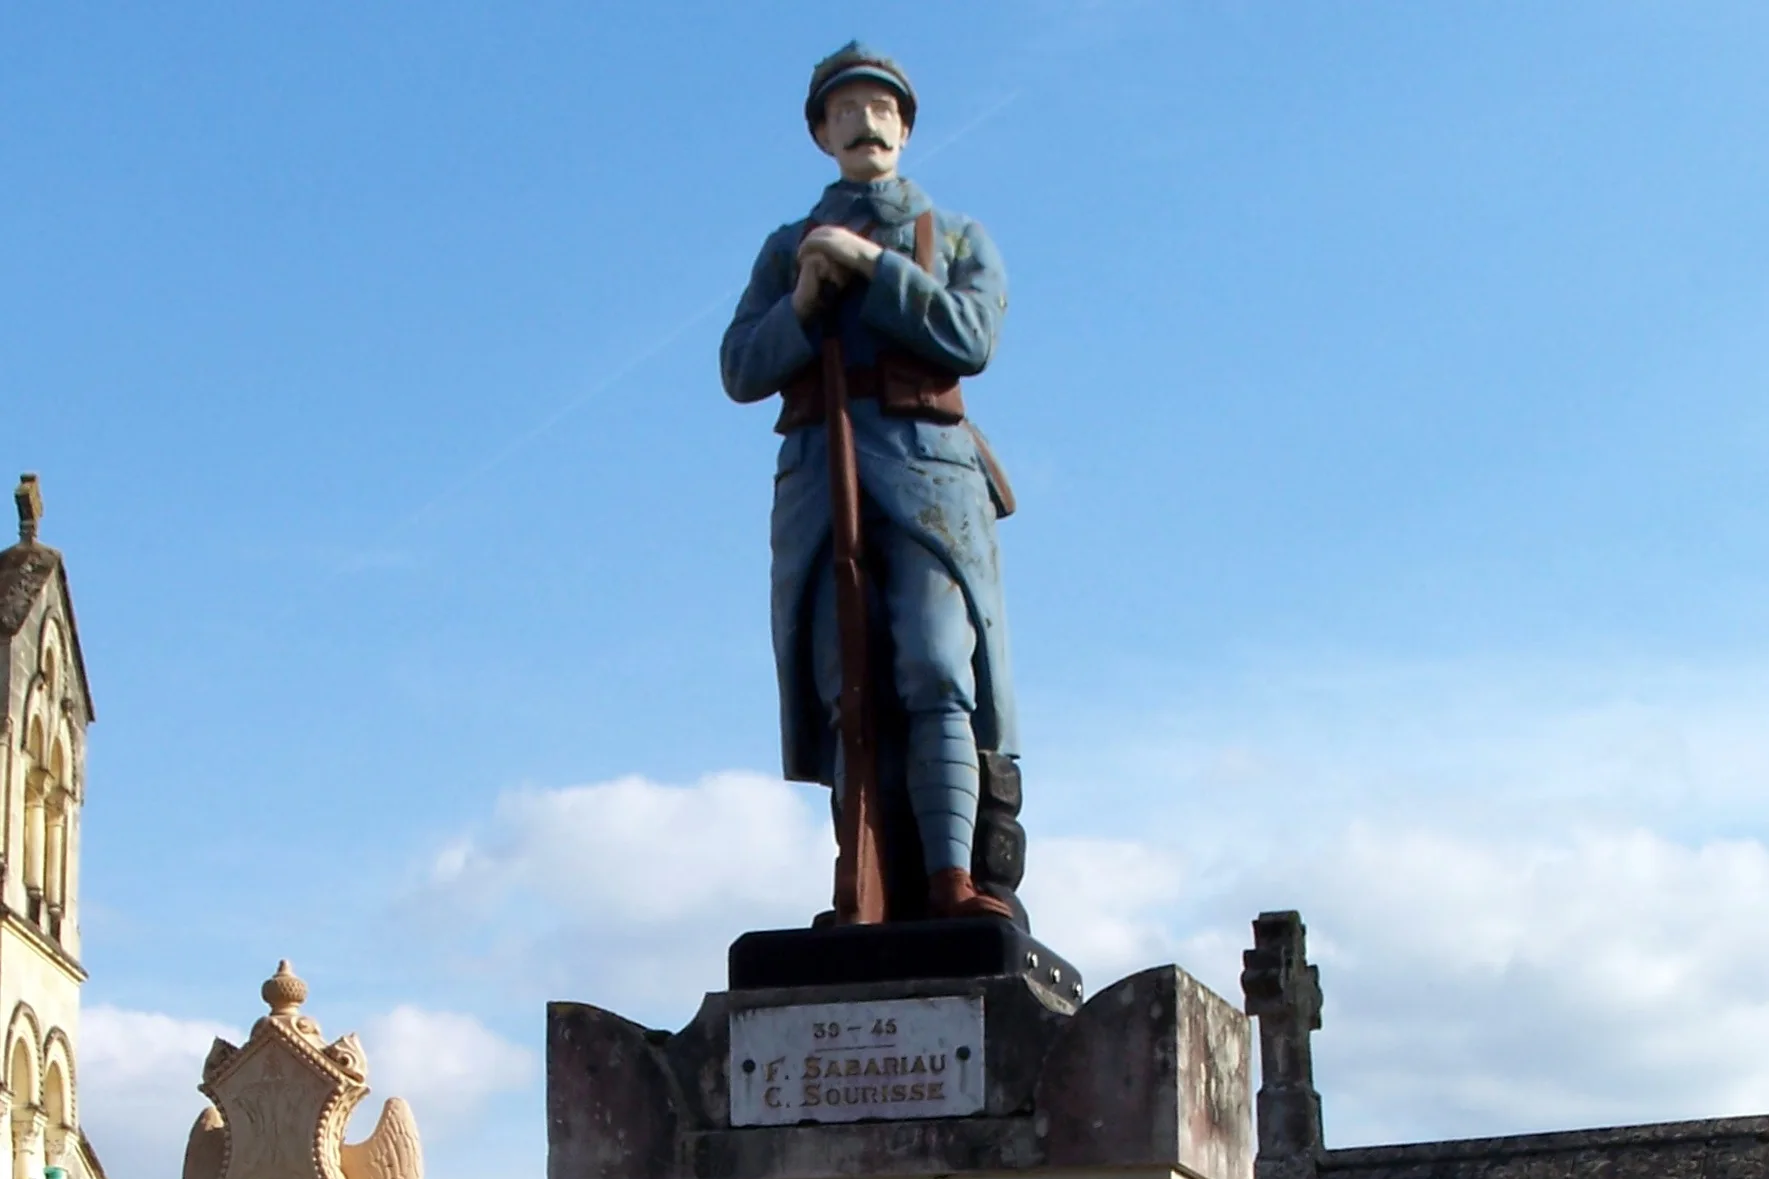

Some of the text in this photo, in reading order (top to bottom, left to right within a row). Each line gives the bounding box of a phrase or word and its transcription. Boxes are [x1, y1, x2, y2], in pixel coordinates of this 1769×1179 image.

[812, 1021, 840, 1041] 39
[869, 1018, 899, 1038] 45
[800, 1081, 947, 1108] SOURISSE
